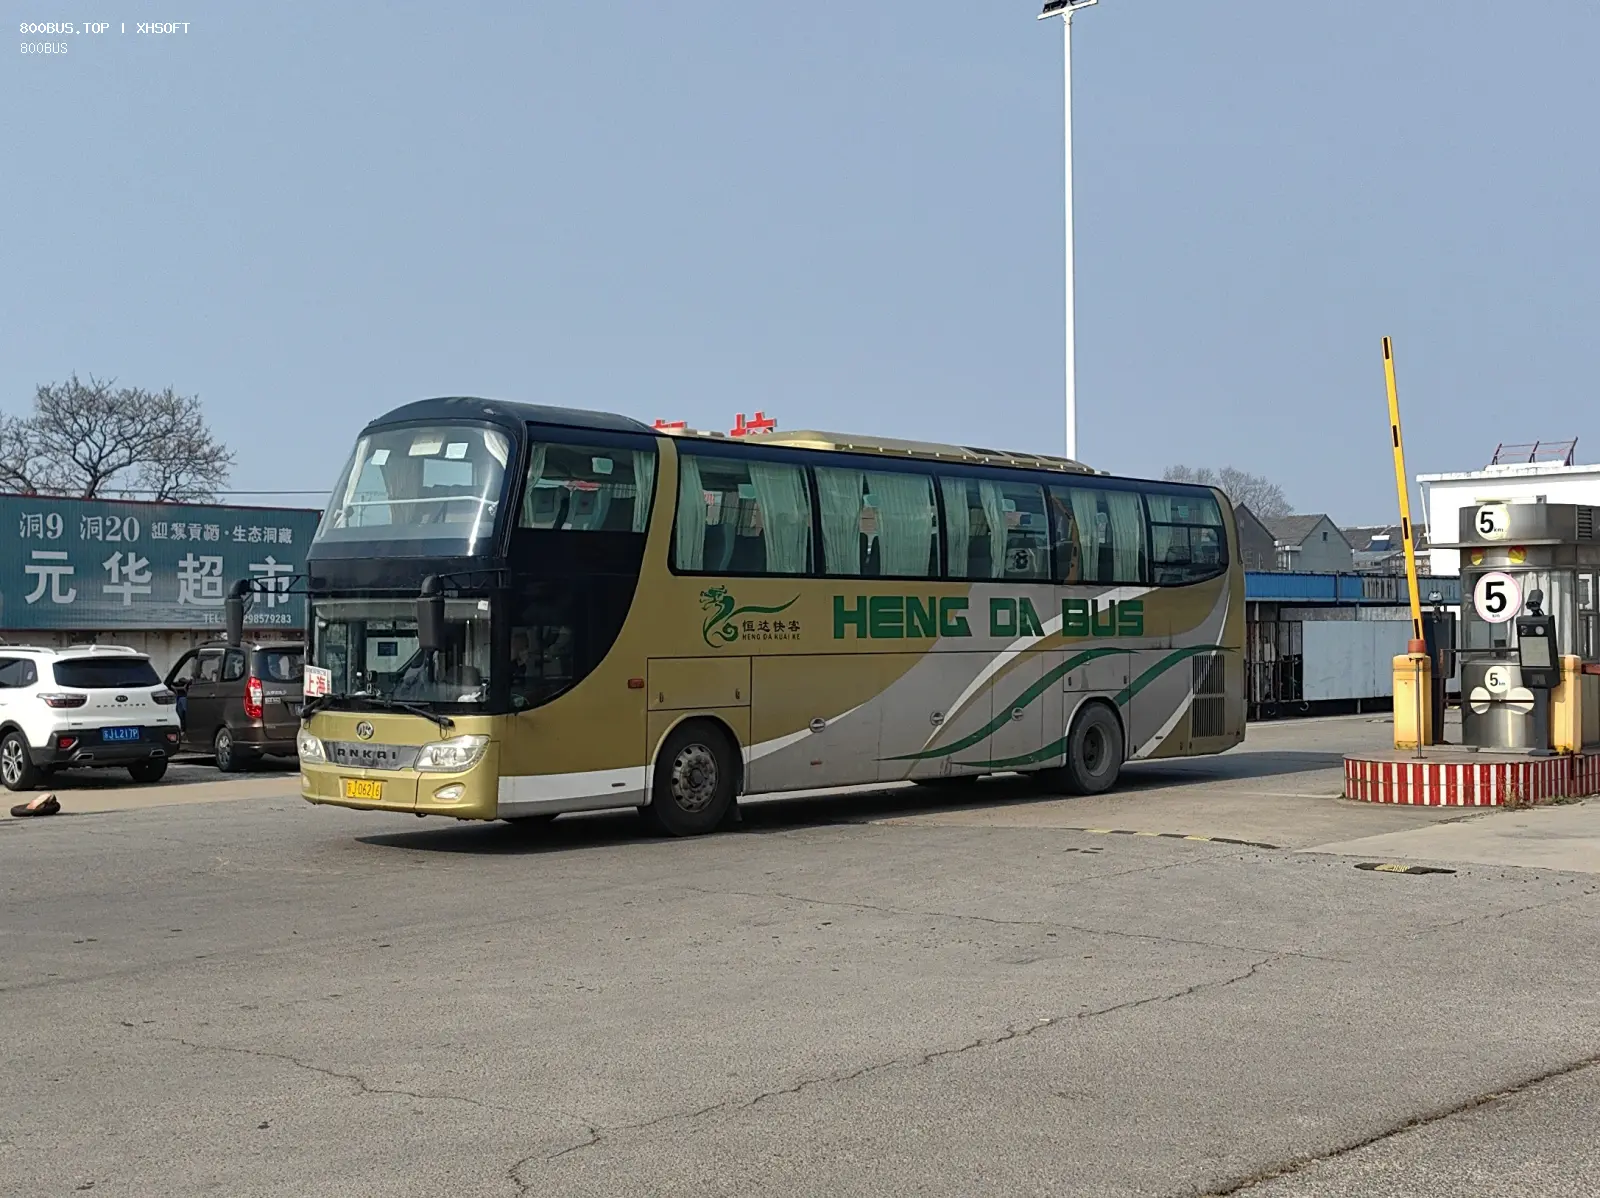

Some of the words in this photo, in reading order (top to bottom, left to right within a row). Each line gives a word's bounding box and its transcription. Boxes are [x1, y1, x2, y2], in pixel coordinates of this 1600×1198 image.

[20, 512, 64, 540] 洞9
[80, 514, 140, 542] 洞20
[1480, 511, 1494, 534] 5
[25, 550, 294, 608] 元华超市
[1485, 581, 1507, 613] 5
[742, 619, 801, 633] 恒达快客
[833, 595, 972, 639] HENG
[989, 597, 1045, 637] DA
[1062, 598, 1144, 637] BUS
[1490, 672, 1499, 686] 5
[337, 748, 396, 760] ANKAI
